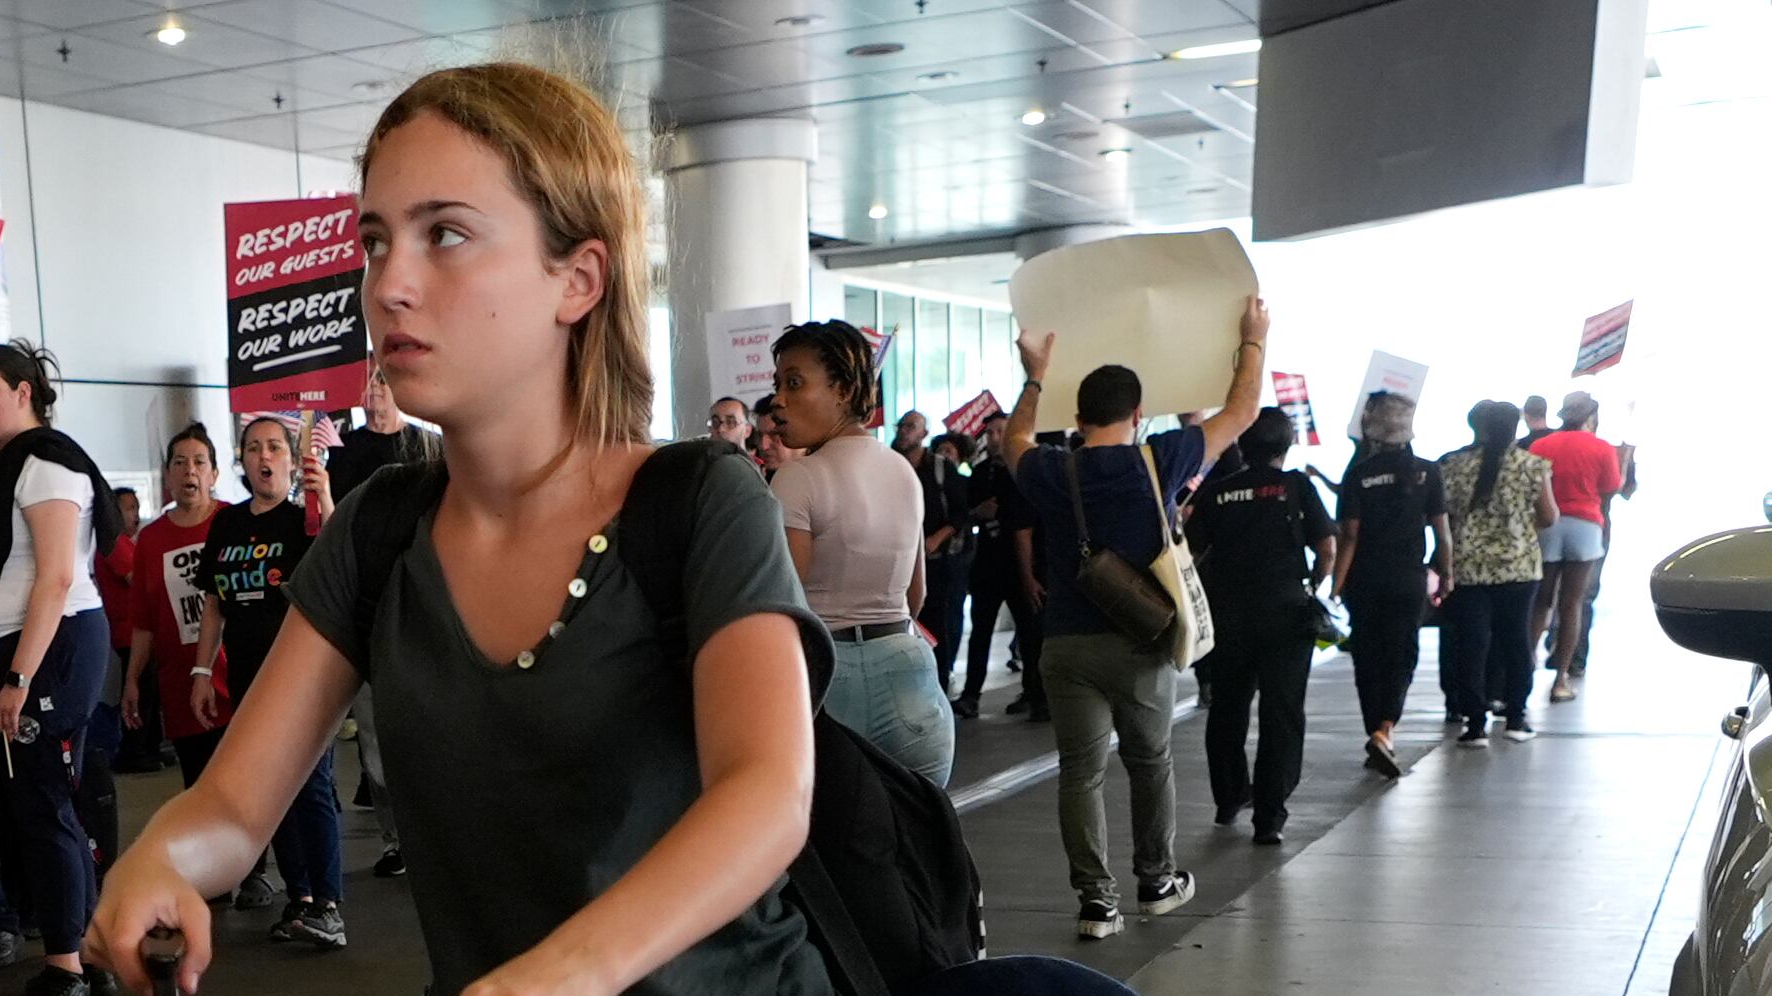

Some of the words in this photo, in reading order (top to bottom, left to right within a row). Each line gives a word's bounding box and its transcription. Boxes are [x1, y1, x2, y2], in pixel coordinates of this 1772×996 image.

[236, 208, 353, 260] RESPECT
[235, 261, 276, 286] OUR
[280, 240, 355, 275] GUESTS
[237, 287, 356, 334] RESPECT
[237, 333, 282, 361] OUR
[288, 316, 356, 349] WORK
[173, 550, 203, 568] ON
[217, 537, 284, 562] union
[214, 560, 282, 600] pride
